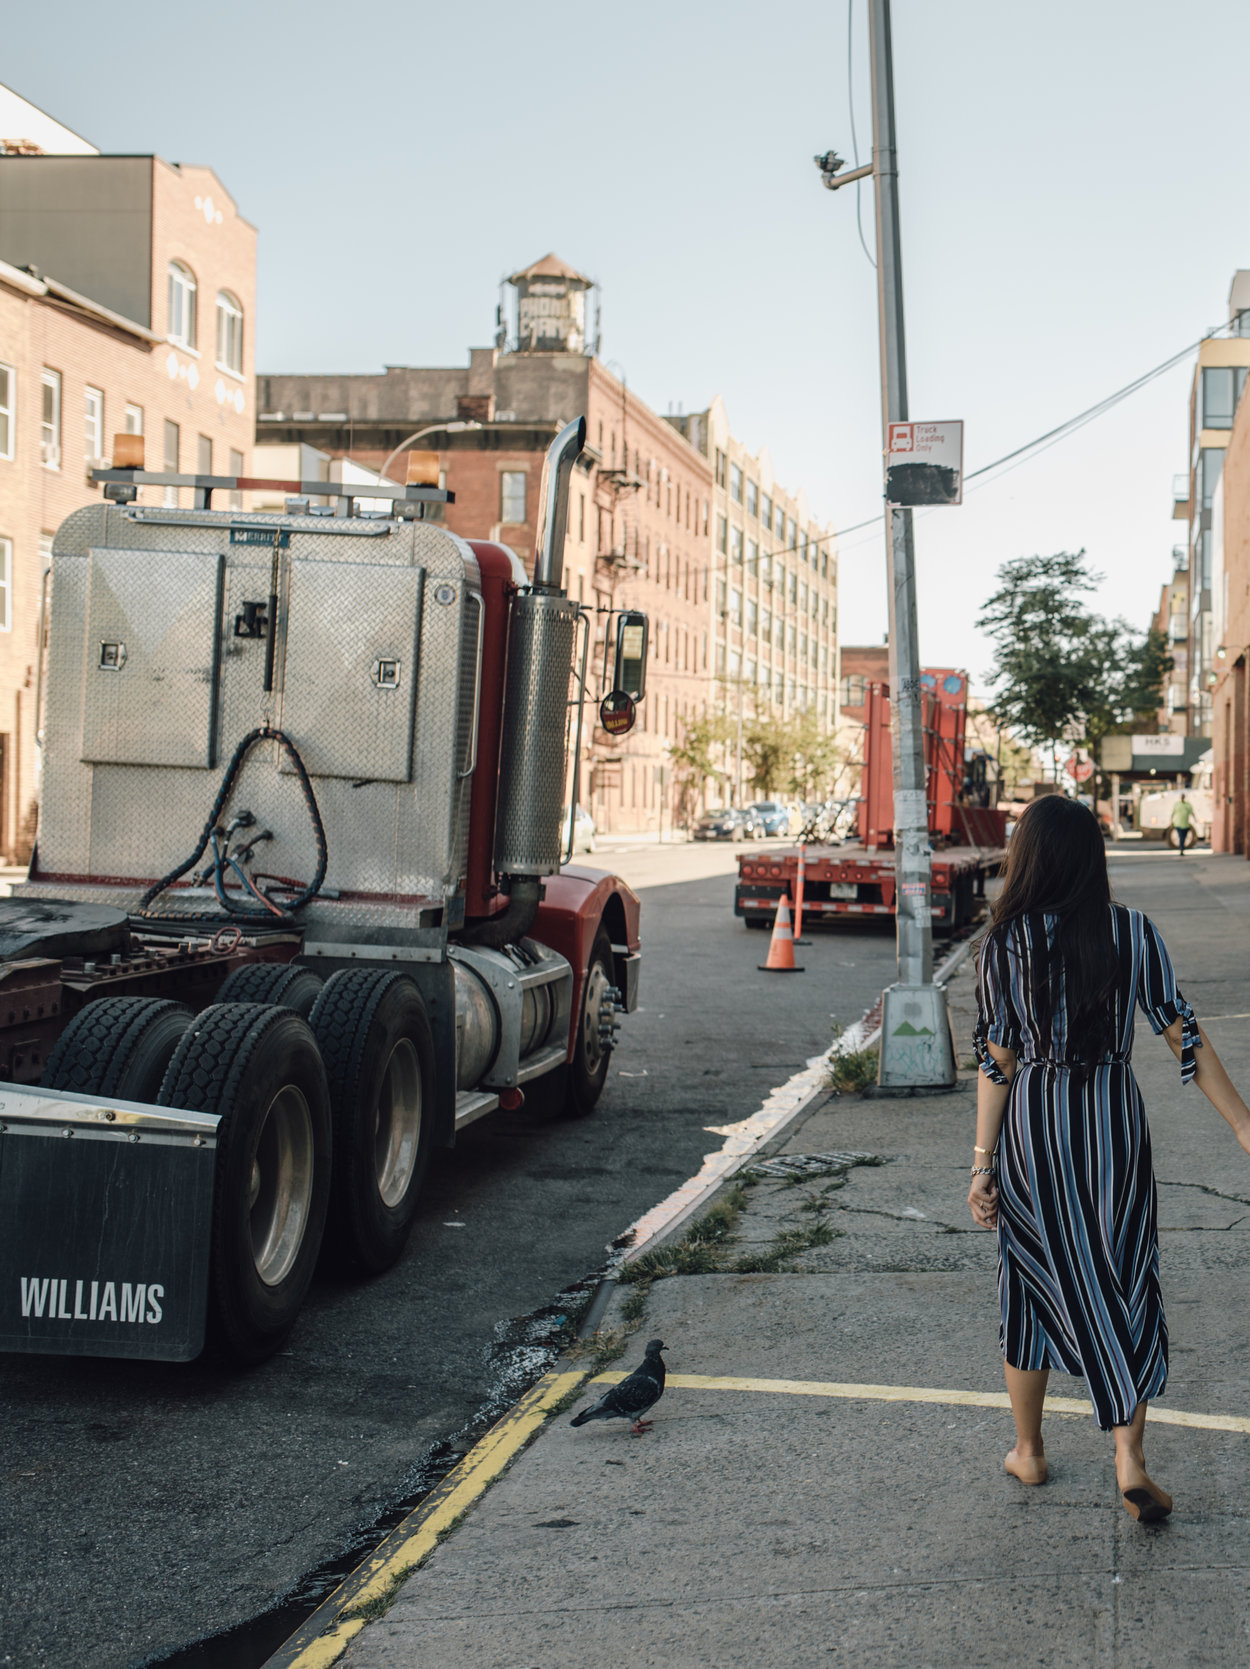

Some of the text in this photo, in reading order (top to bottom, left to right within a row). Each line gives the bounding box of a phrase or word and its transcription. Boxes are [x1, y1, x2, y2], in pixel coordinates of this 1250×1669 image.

[916, 425, 936, 434] Truck
[916, 433, 944, 444] Loading
[916, 443, 932, 453] Only
[20, 1276, 165, 1324] WILLIAMS
